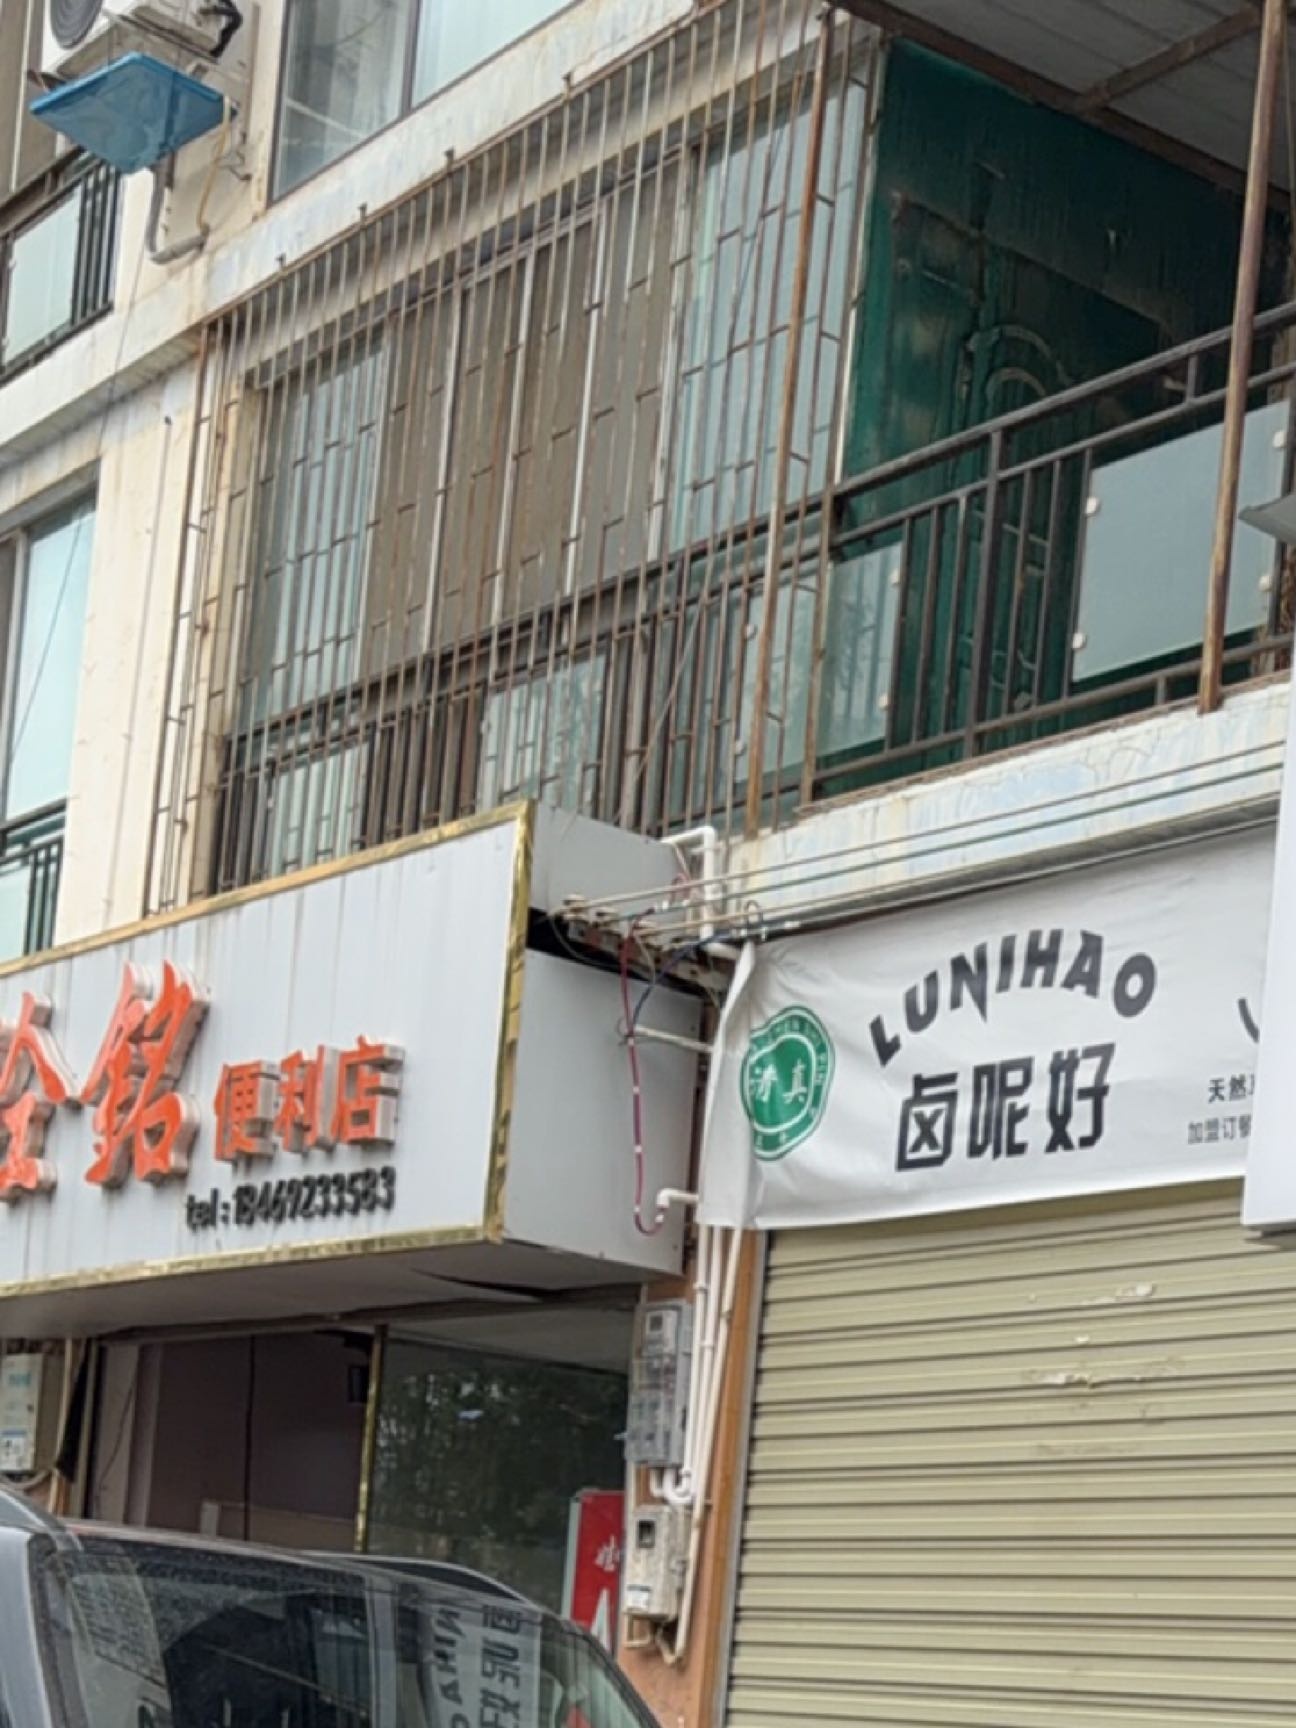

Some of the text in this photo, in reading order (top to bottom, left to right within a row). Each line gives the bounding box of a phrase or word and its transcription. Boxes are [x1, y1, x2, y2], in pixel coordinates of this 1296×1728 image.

[869, 928, 1156, 1067] LUNIHAO
[213, 1034, 392, 1162] 便利店
[895, 1042, 1116, 1172] 卤呢好
